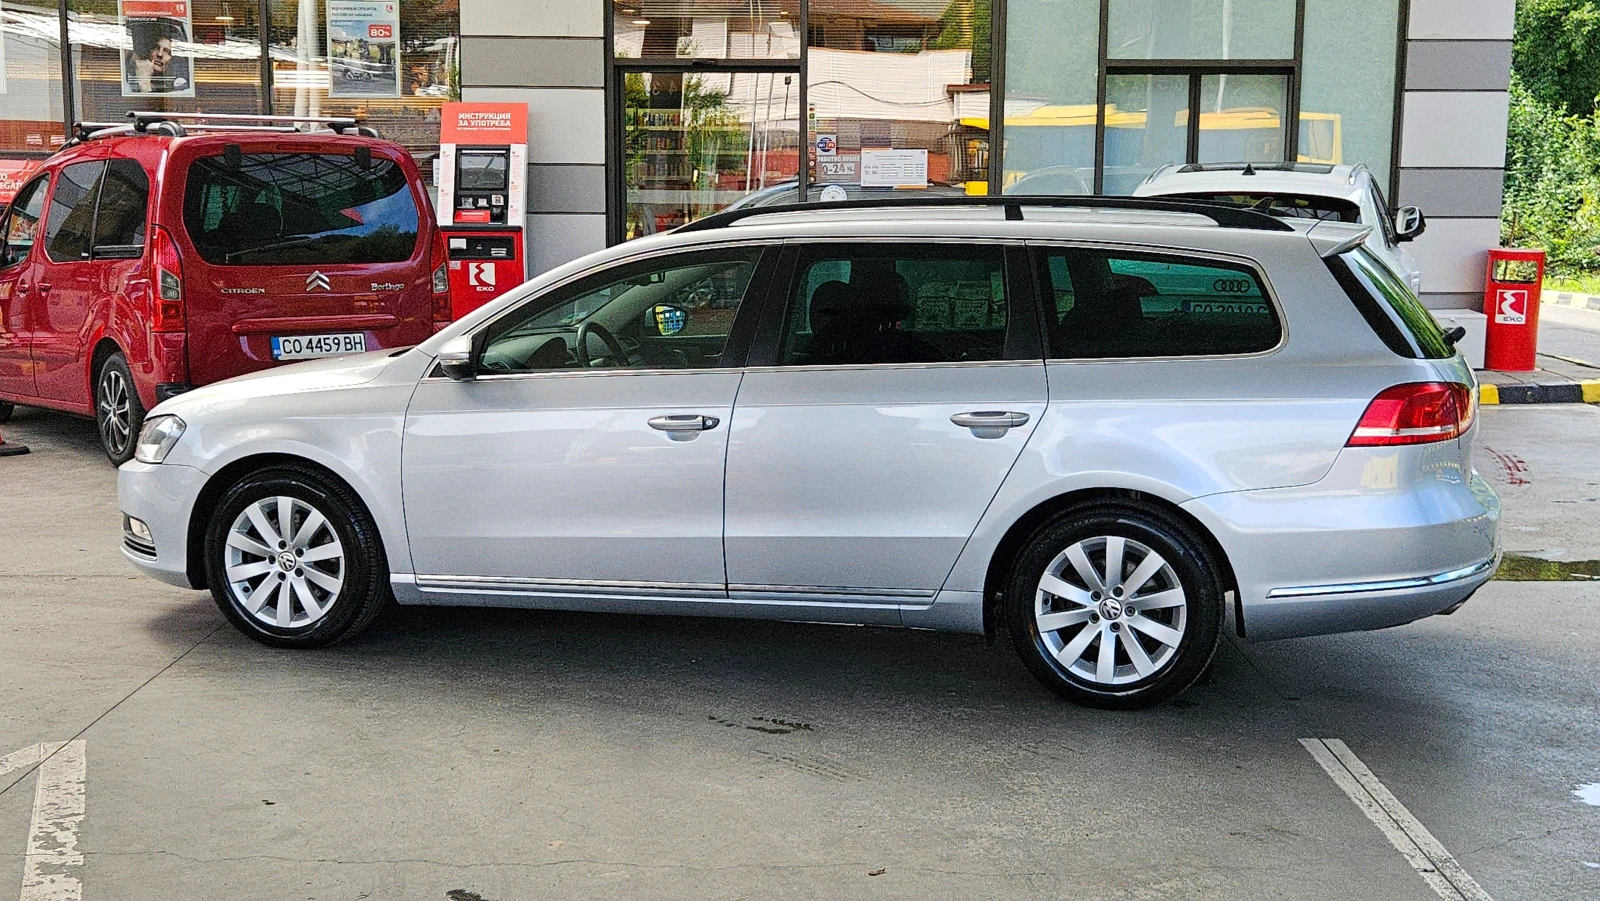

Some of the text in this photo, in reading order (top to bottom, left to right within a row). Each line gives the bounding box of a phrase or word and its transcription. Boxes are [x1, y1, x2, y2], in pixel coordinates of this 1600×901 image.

[370, 29, 391, 37] 80%
[458, 112, 511, 120] ИНСТРУКЦИЯ
[370, 282, 405, 292] Berlingo
[282, 335, 364, 354] CO 4459 BH
